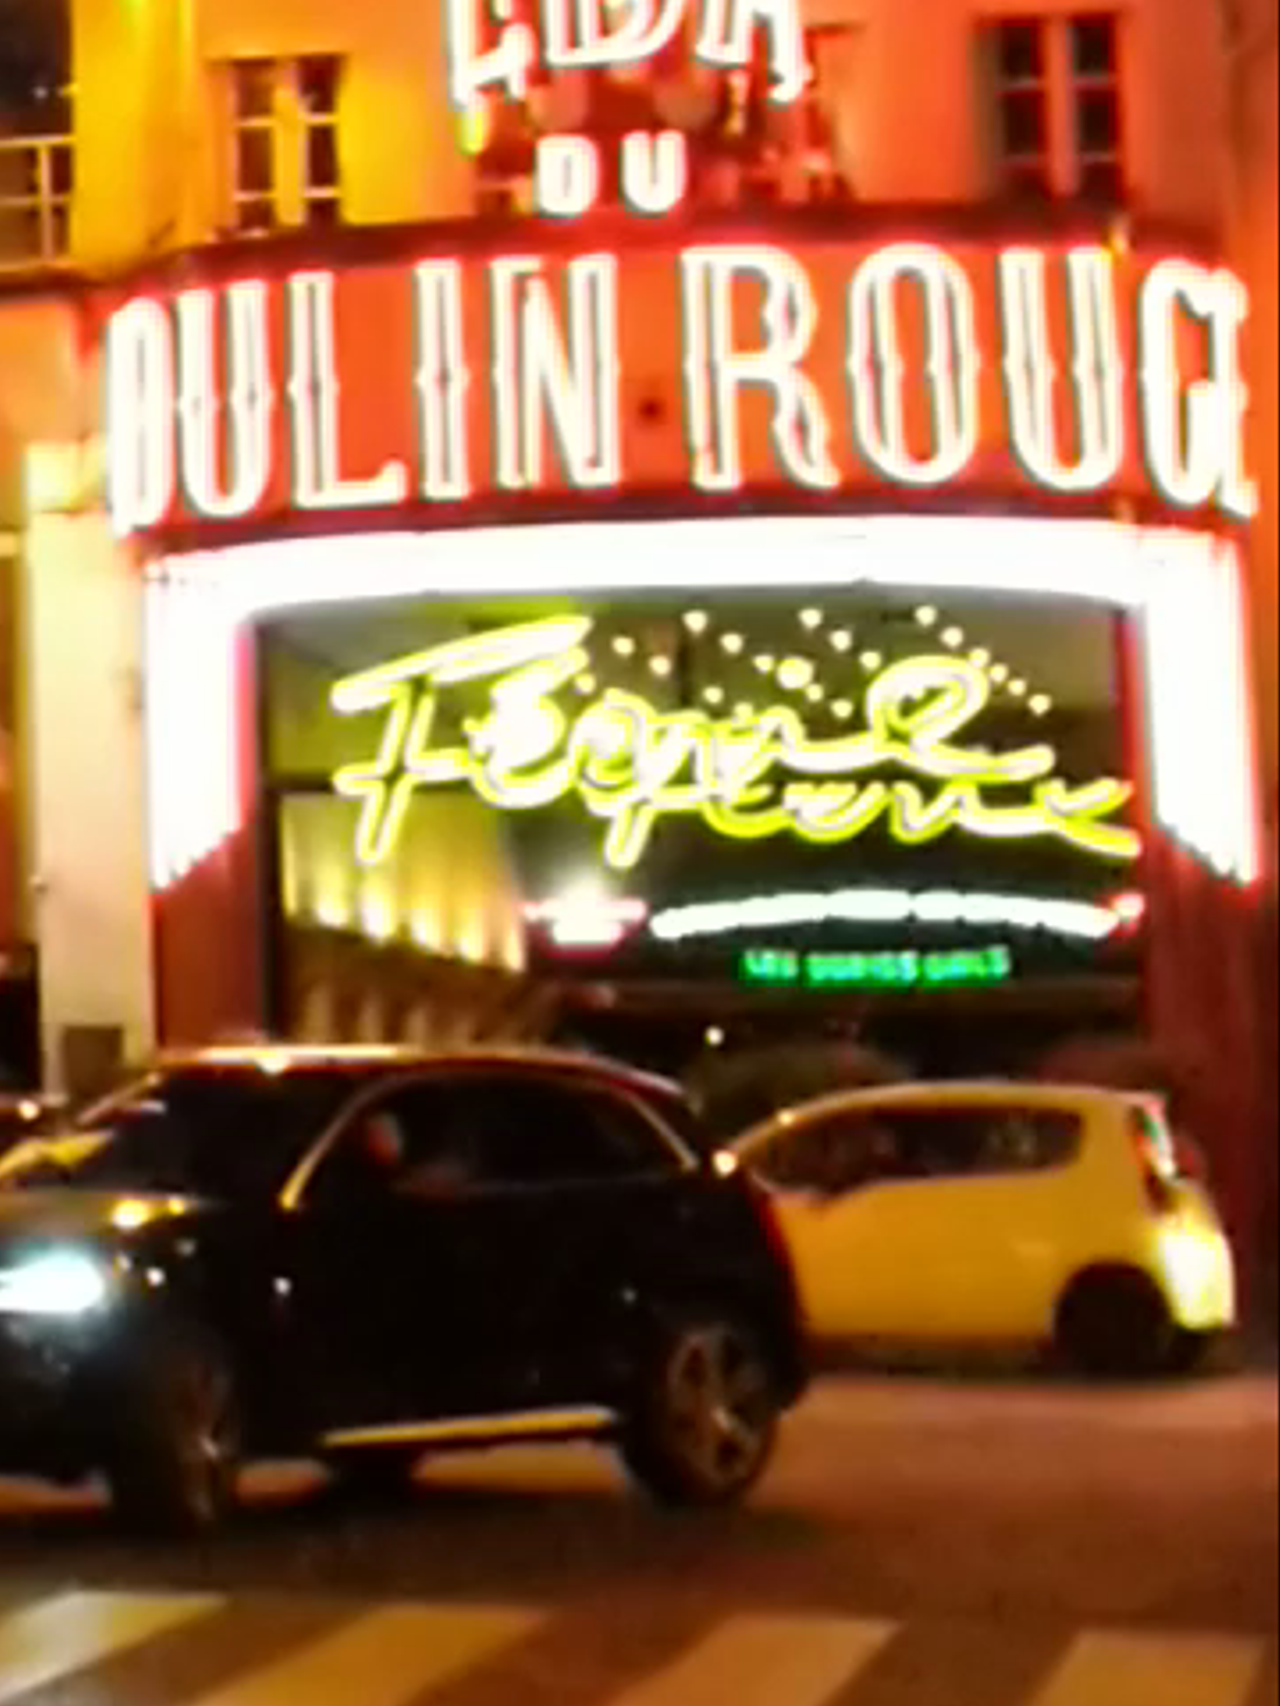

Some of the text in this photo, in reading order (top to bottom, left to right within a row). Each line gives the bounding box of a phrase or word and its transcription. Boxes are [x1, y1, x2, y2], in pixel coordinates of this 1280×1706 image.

[536, 129, 688, 217] DU
[107, 241, 1260, 538] OULIN ROUG
